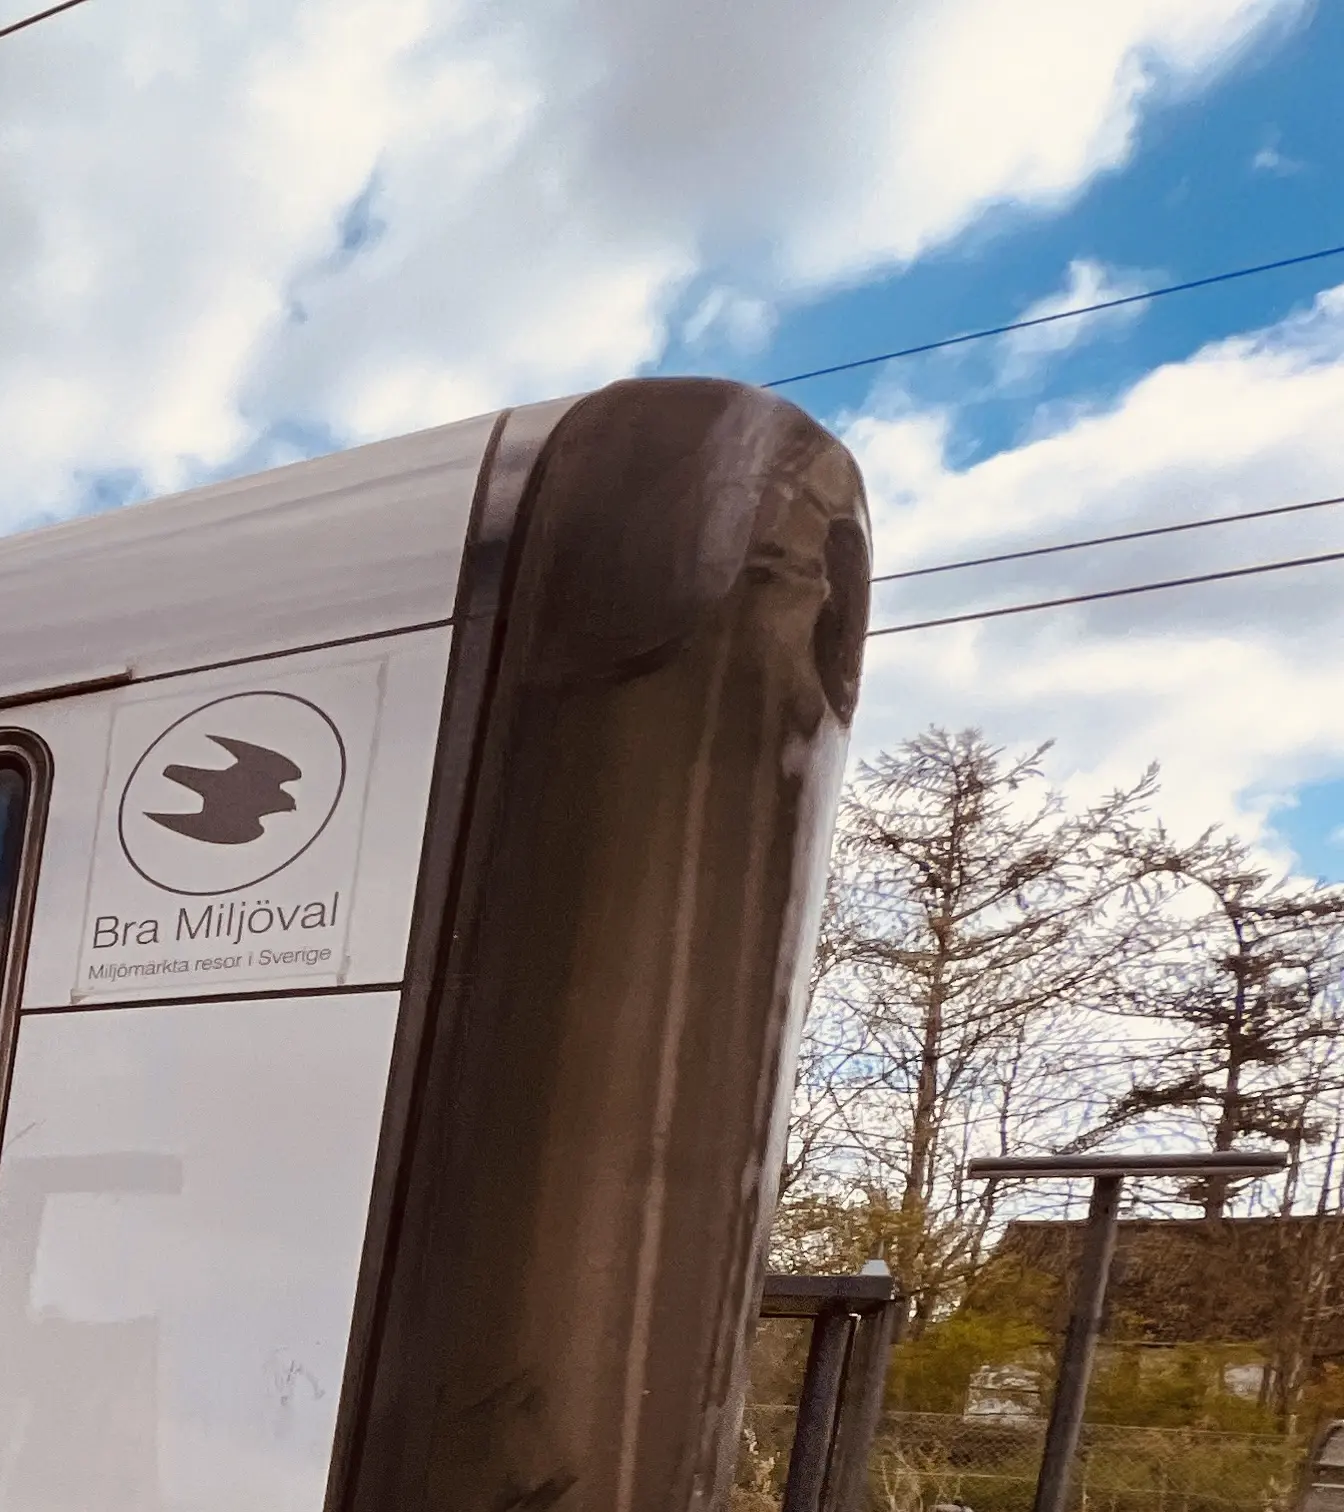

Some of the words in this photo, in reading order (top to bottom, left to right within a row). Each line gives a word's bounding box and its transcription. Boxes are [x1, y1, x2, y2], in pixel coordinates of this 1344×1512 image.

[92, 914, 158, 949] Bra
[175, 890, 340, 944] Miljöval
[88, 958, 190, 983] Miljömärkta
[194, 953, 243, 972] resor
[258, 947, 332, 967] Sverige
